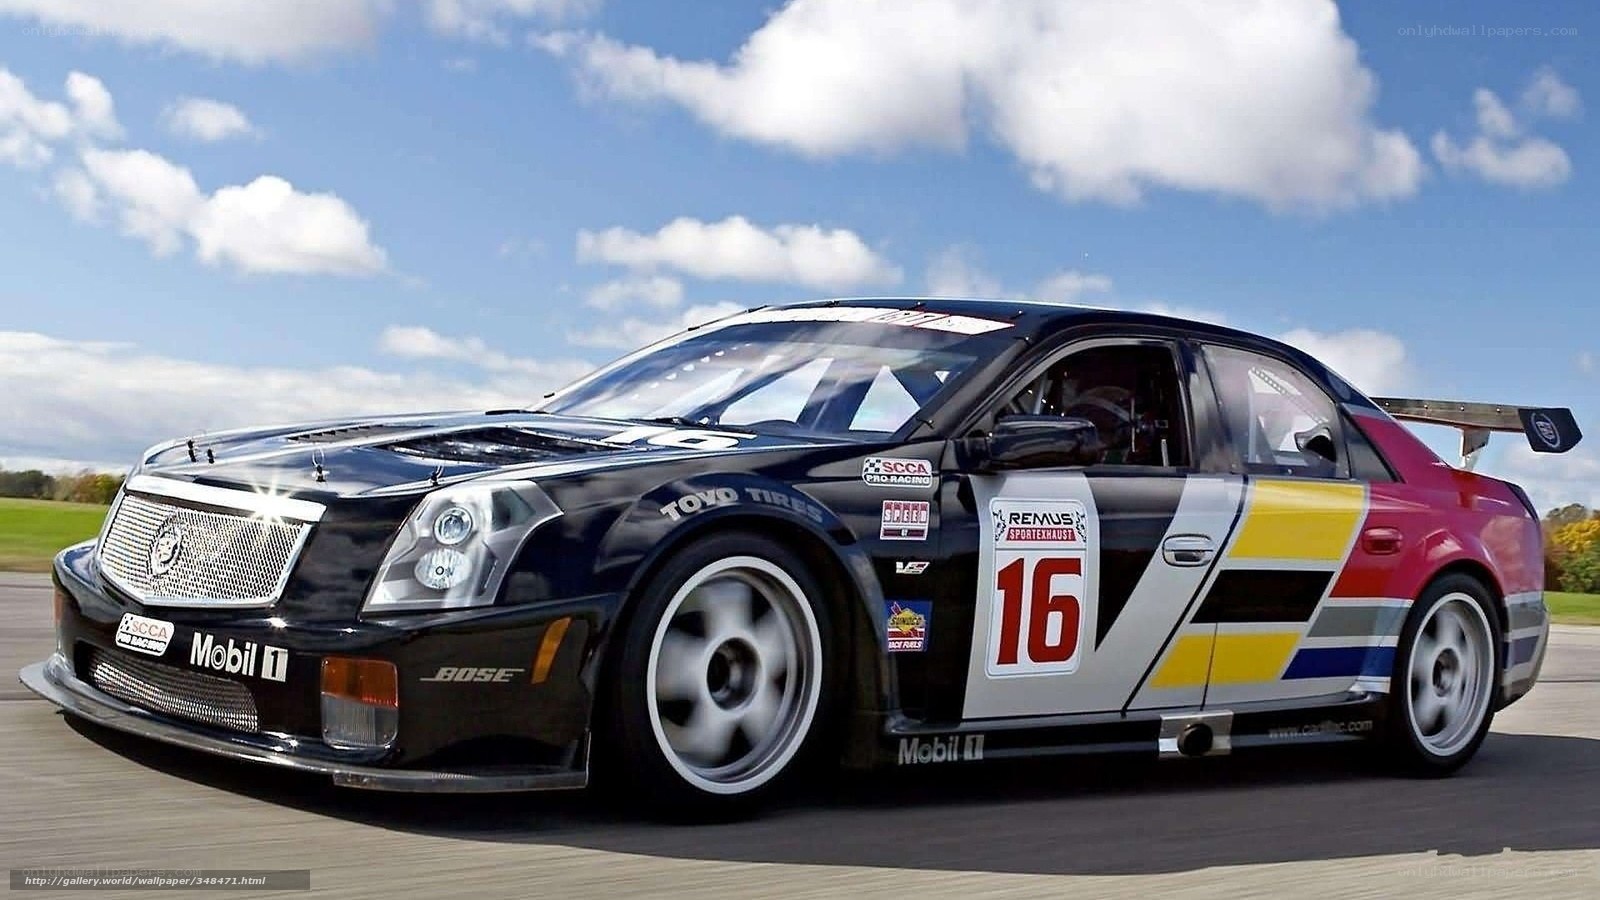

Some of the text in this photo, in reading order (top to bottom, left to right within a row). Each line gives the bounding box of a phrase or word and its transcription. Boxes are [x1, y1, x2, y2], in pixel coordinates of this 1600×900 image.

[882, 461, 929, 475] SCCA
[866, 474, 930, 484] PRO RACING
[659, 487, 823, 523] TOYO TIRES
[883, 508, 927, 523] SPEED
[1008, 512, 1074, 525] REMUS
[1008, 529, 1073, 541] SPORTEXHAUST
[996, 557, 1082, 665] 16
[131, 620, 168, 639] SCCA
[190, 631, 288, 682] Mobil 1
[420, 666, 525, 683] BOSE
[898, 734, 985, 765] Mobil 1
